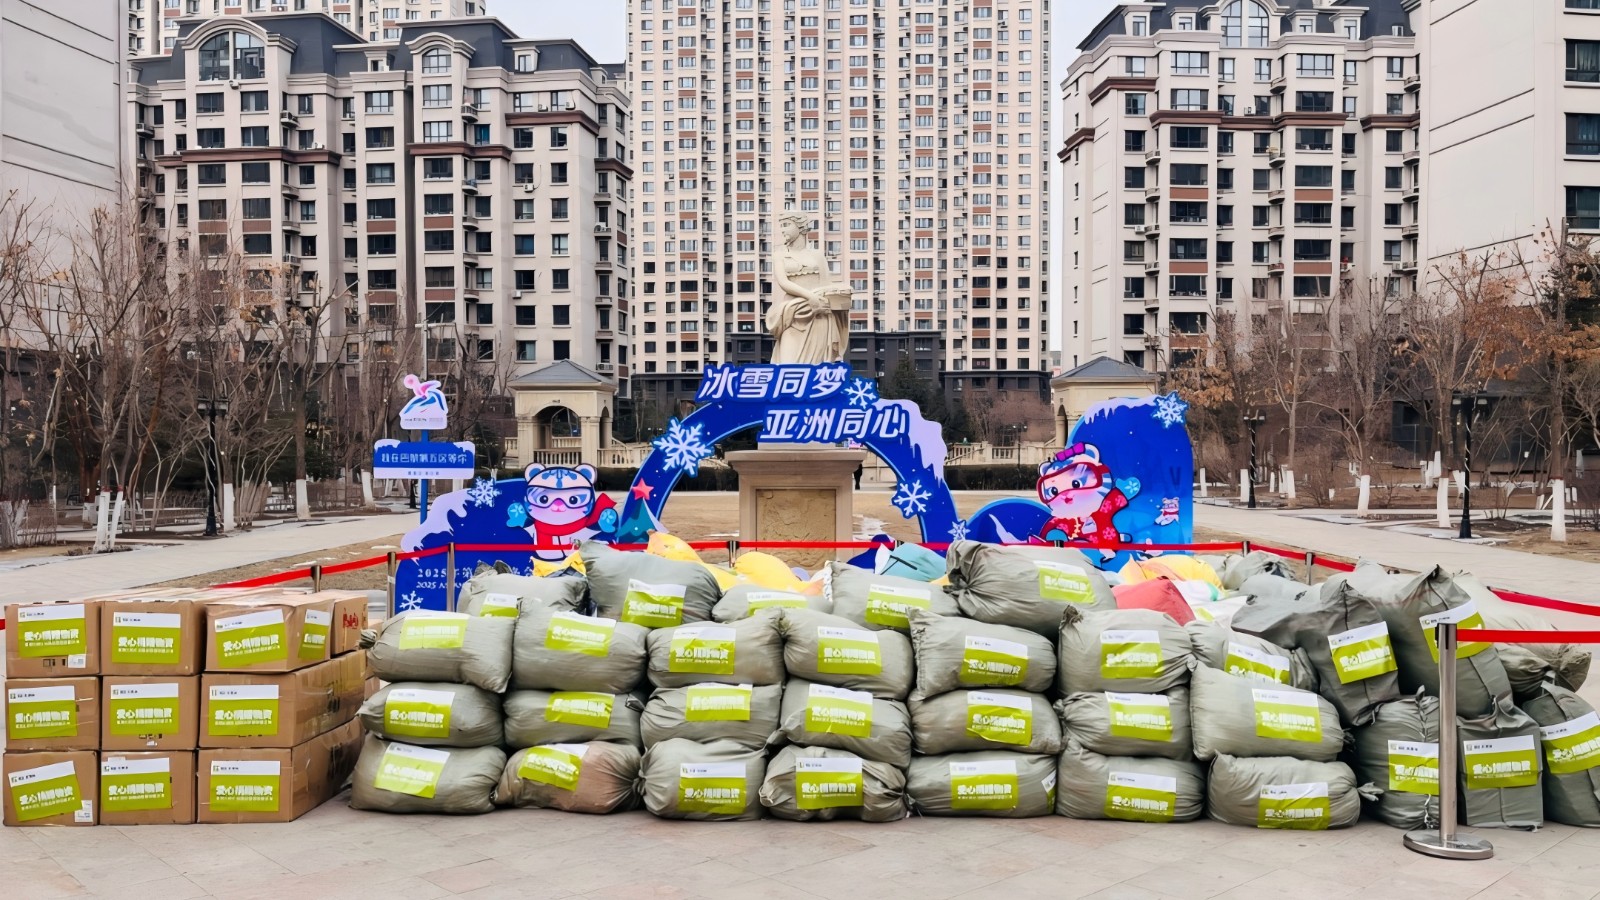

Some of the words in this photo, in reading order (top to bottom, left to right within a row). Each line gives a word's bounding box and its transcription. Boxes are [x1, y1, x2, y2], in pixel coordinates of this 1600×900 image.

[698, 366, 849, 400] 冰雪同梦
[760, 405, 907, 440] 亚洲同心
